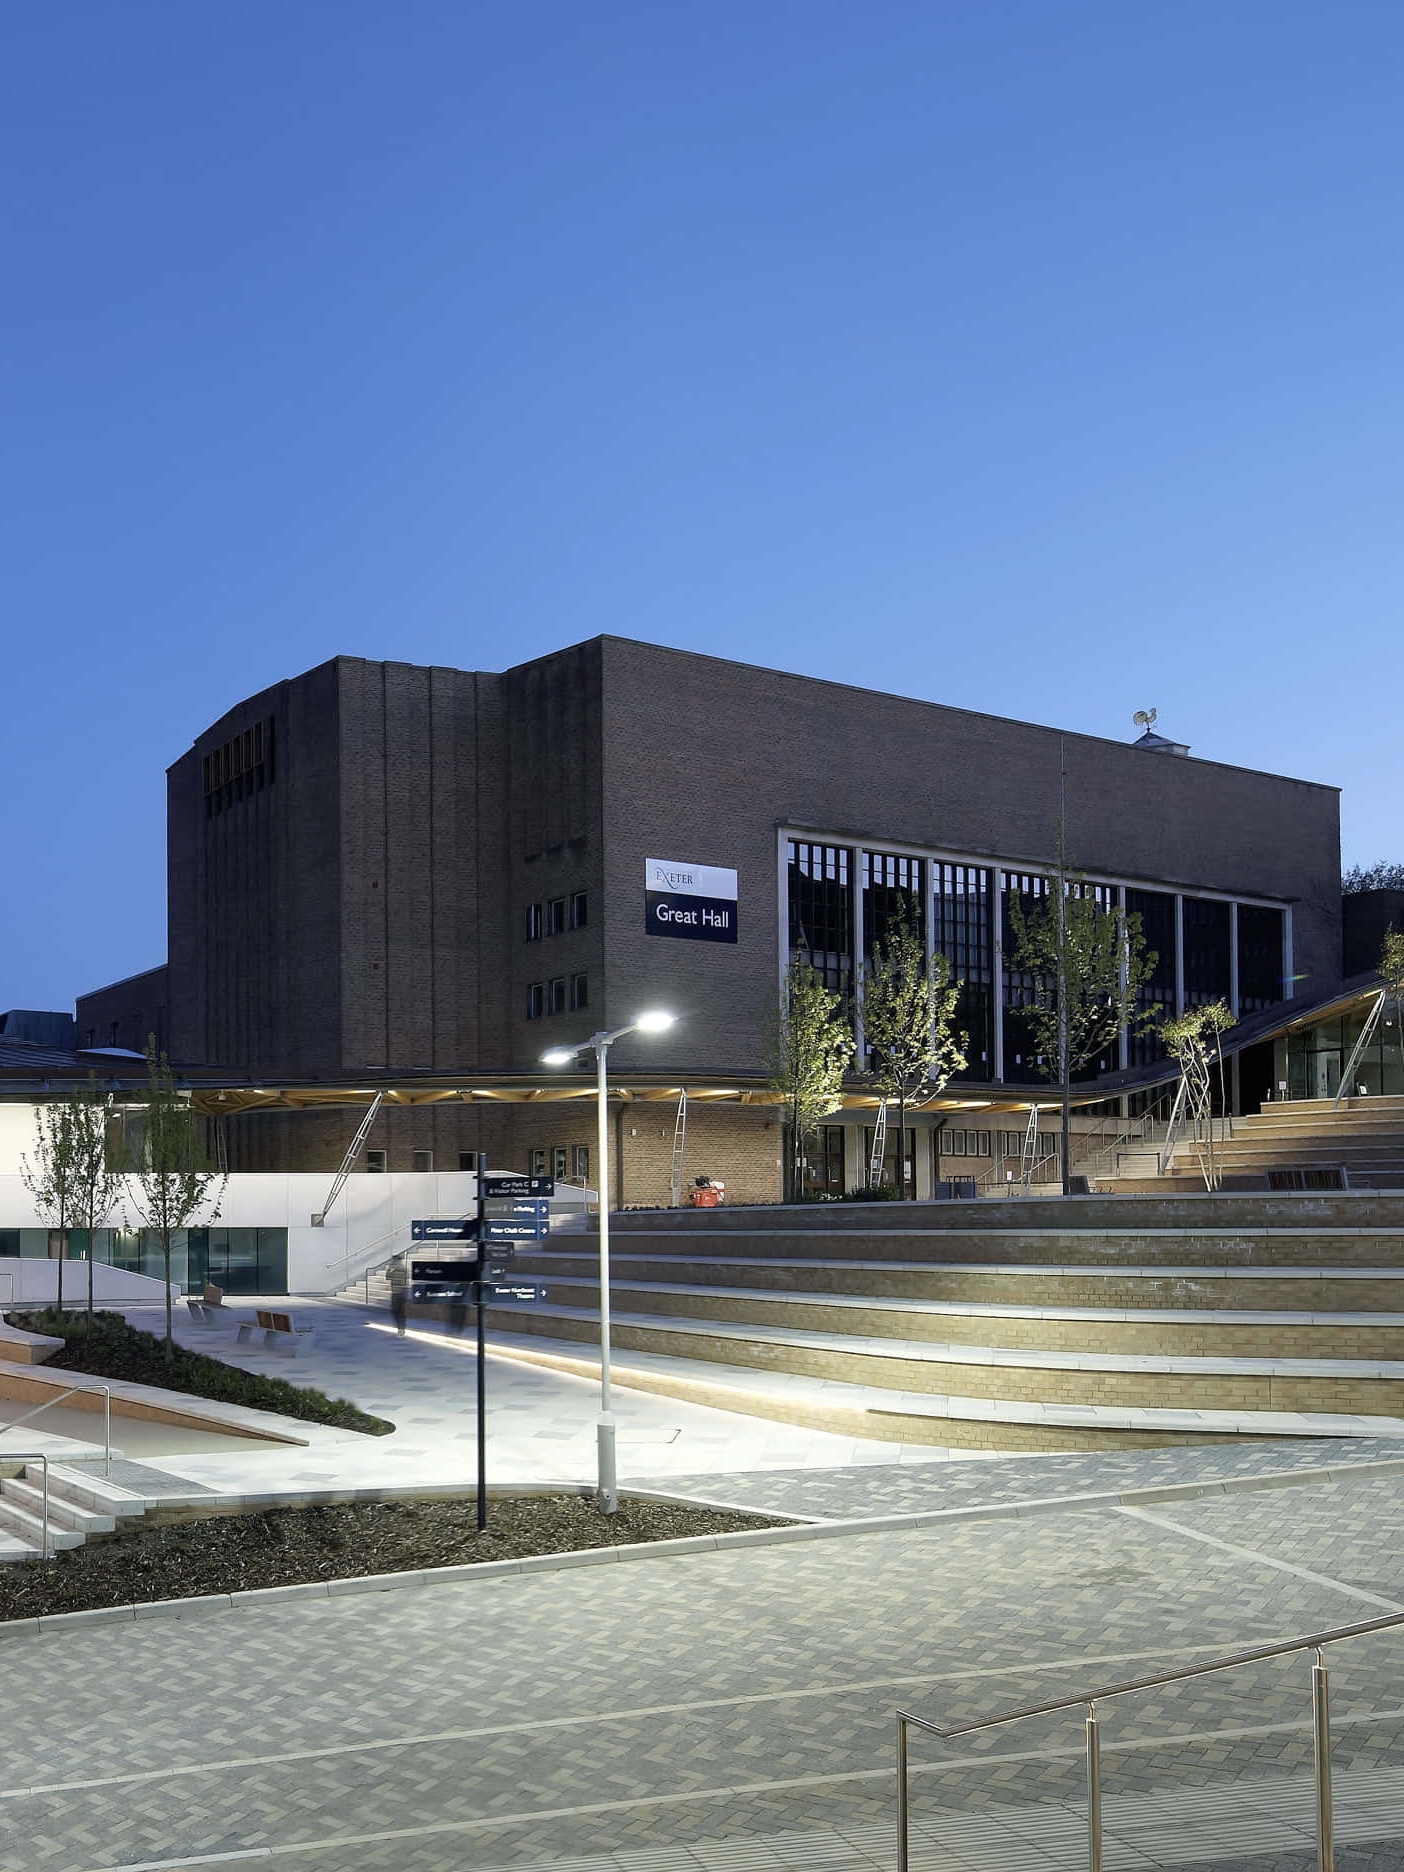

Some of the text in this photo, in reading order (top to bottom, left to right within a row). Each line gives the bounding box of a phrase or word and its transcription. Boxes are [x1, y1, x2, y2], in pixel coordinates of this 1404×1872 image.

[654, 868, 693, 888] EXETER
[656, 904, 729, 928] Great Hall
